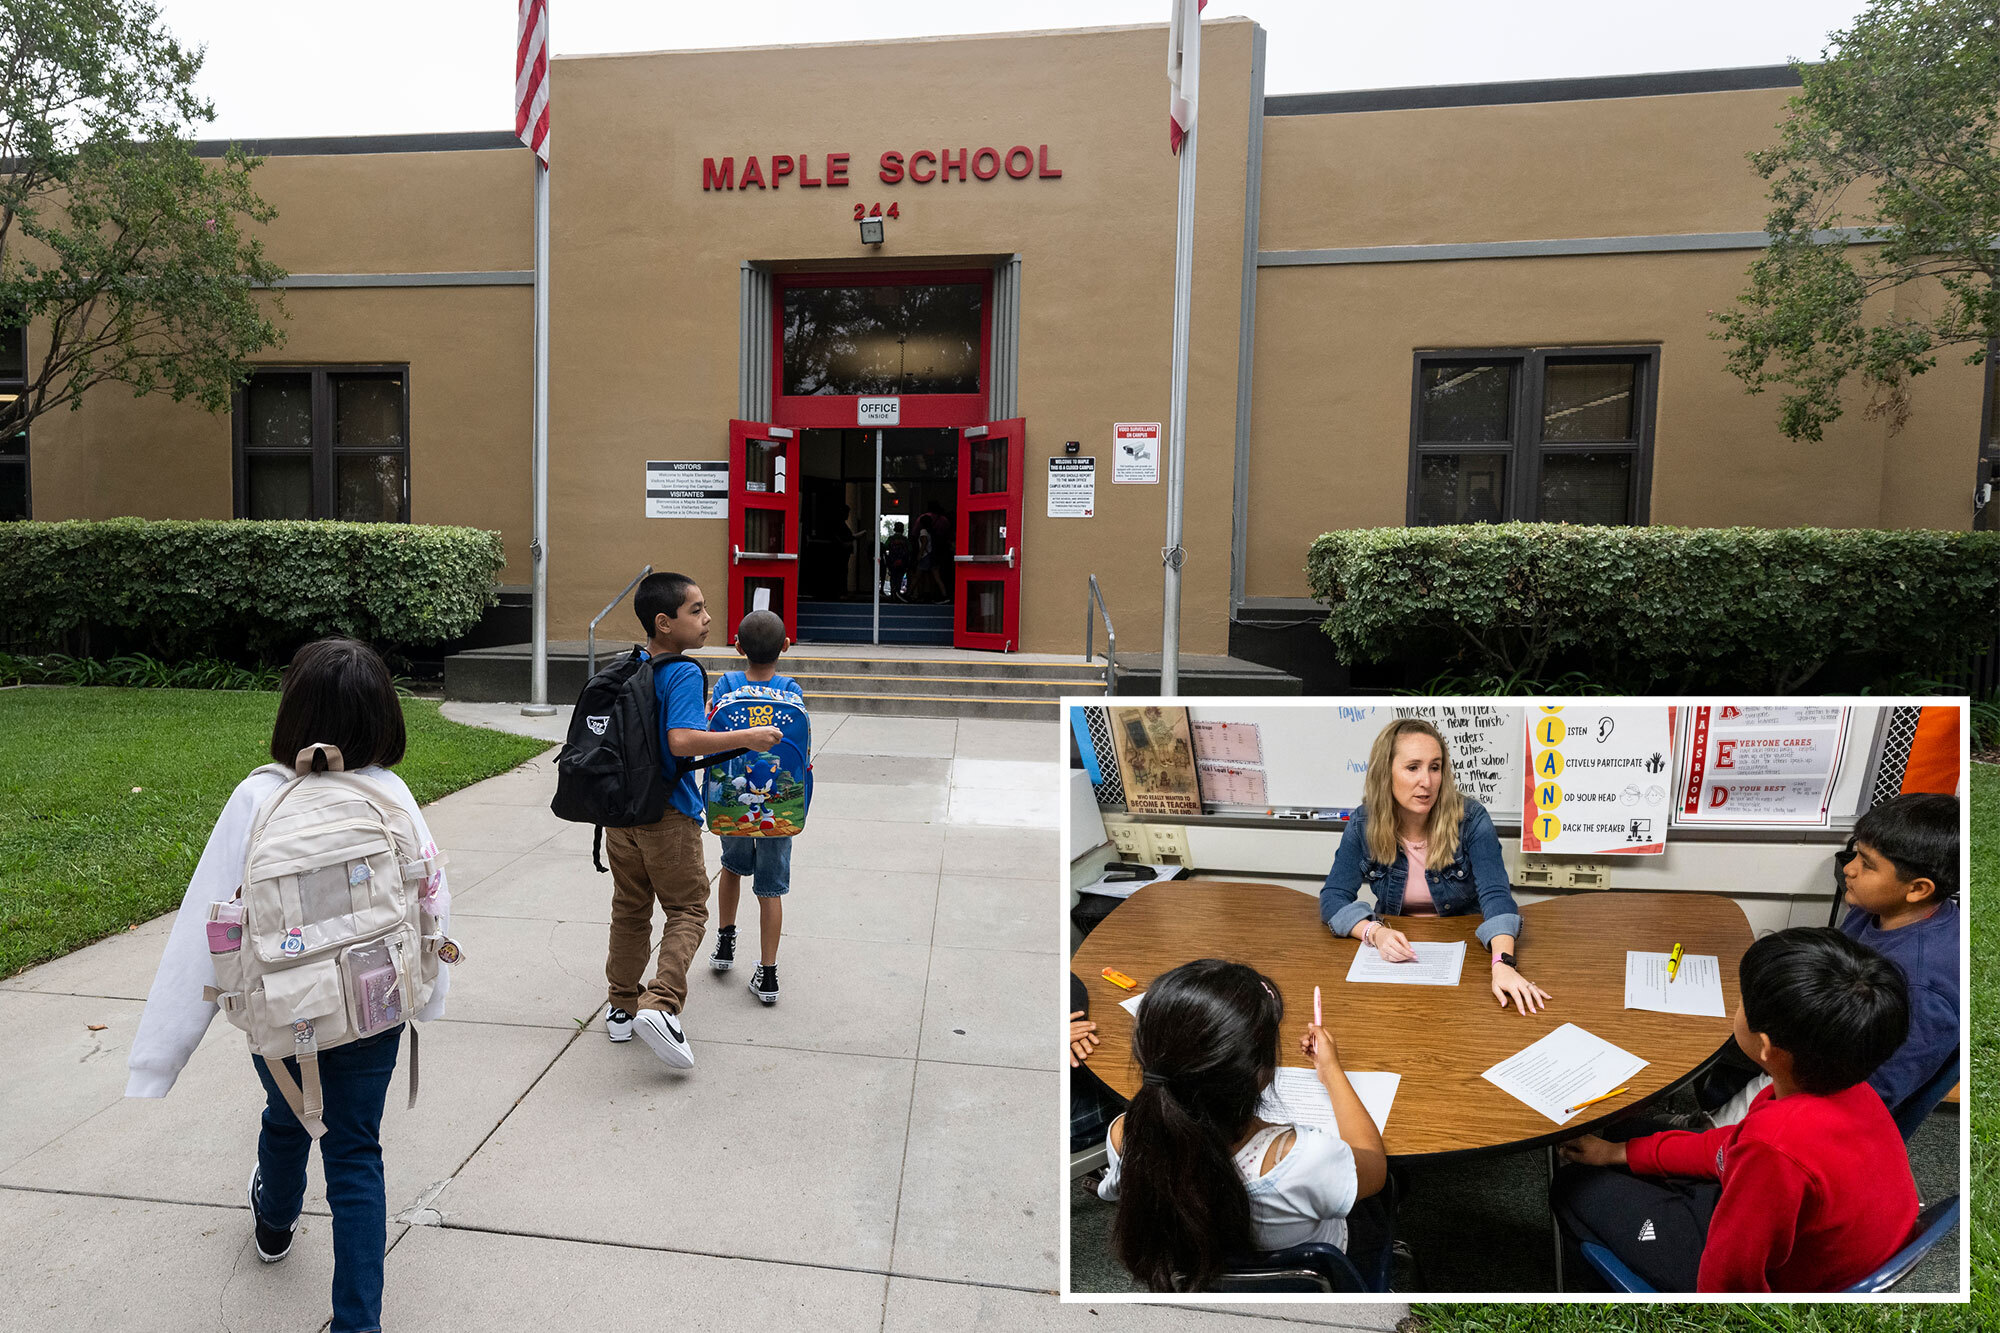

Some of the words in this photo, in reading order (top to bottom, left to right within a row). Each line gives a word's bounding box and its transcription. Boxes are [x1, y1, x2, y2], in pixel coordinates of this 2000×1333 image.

[703, 152, 851, 191] MAPLE
[878, 144, 1063, 184] SCHOOL
[853, 202, 900, 221] 244
[861, 404, 897, 413] OFFICE
[747, 704, 773, 716] TOO
[1396, 706, 1436, 718] mocked
[749, 715, 774, 727] EASY
[1454, 732, 1484, 744] riders
[1783, 739, 1812, 747] CARES
[1467, 756, 1477, 768] at
[1482, 752, 1508, 766] school
[1597, 759, 1642, 767] PARTICIPATE
[1479, 782, 1497, 792] her
[1577, 794, 1597, 802] YOUR
[1598, 793, 1616, 802] HEAD
[1583, 824, 1595, 832] THE
[1596, 824, 1625, 832] SPEAKER
